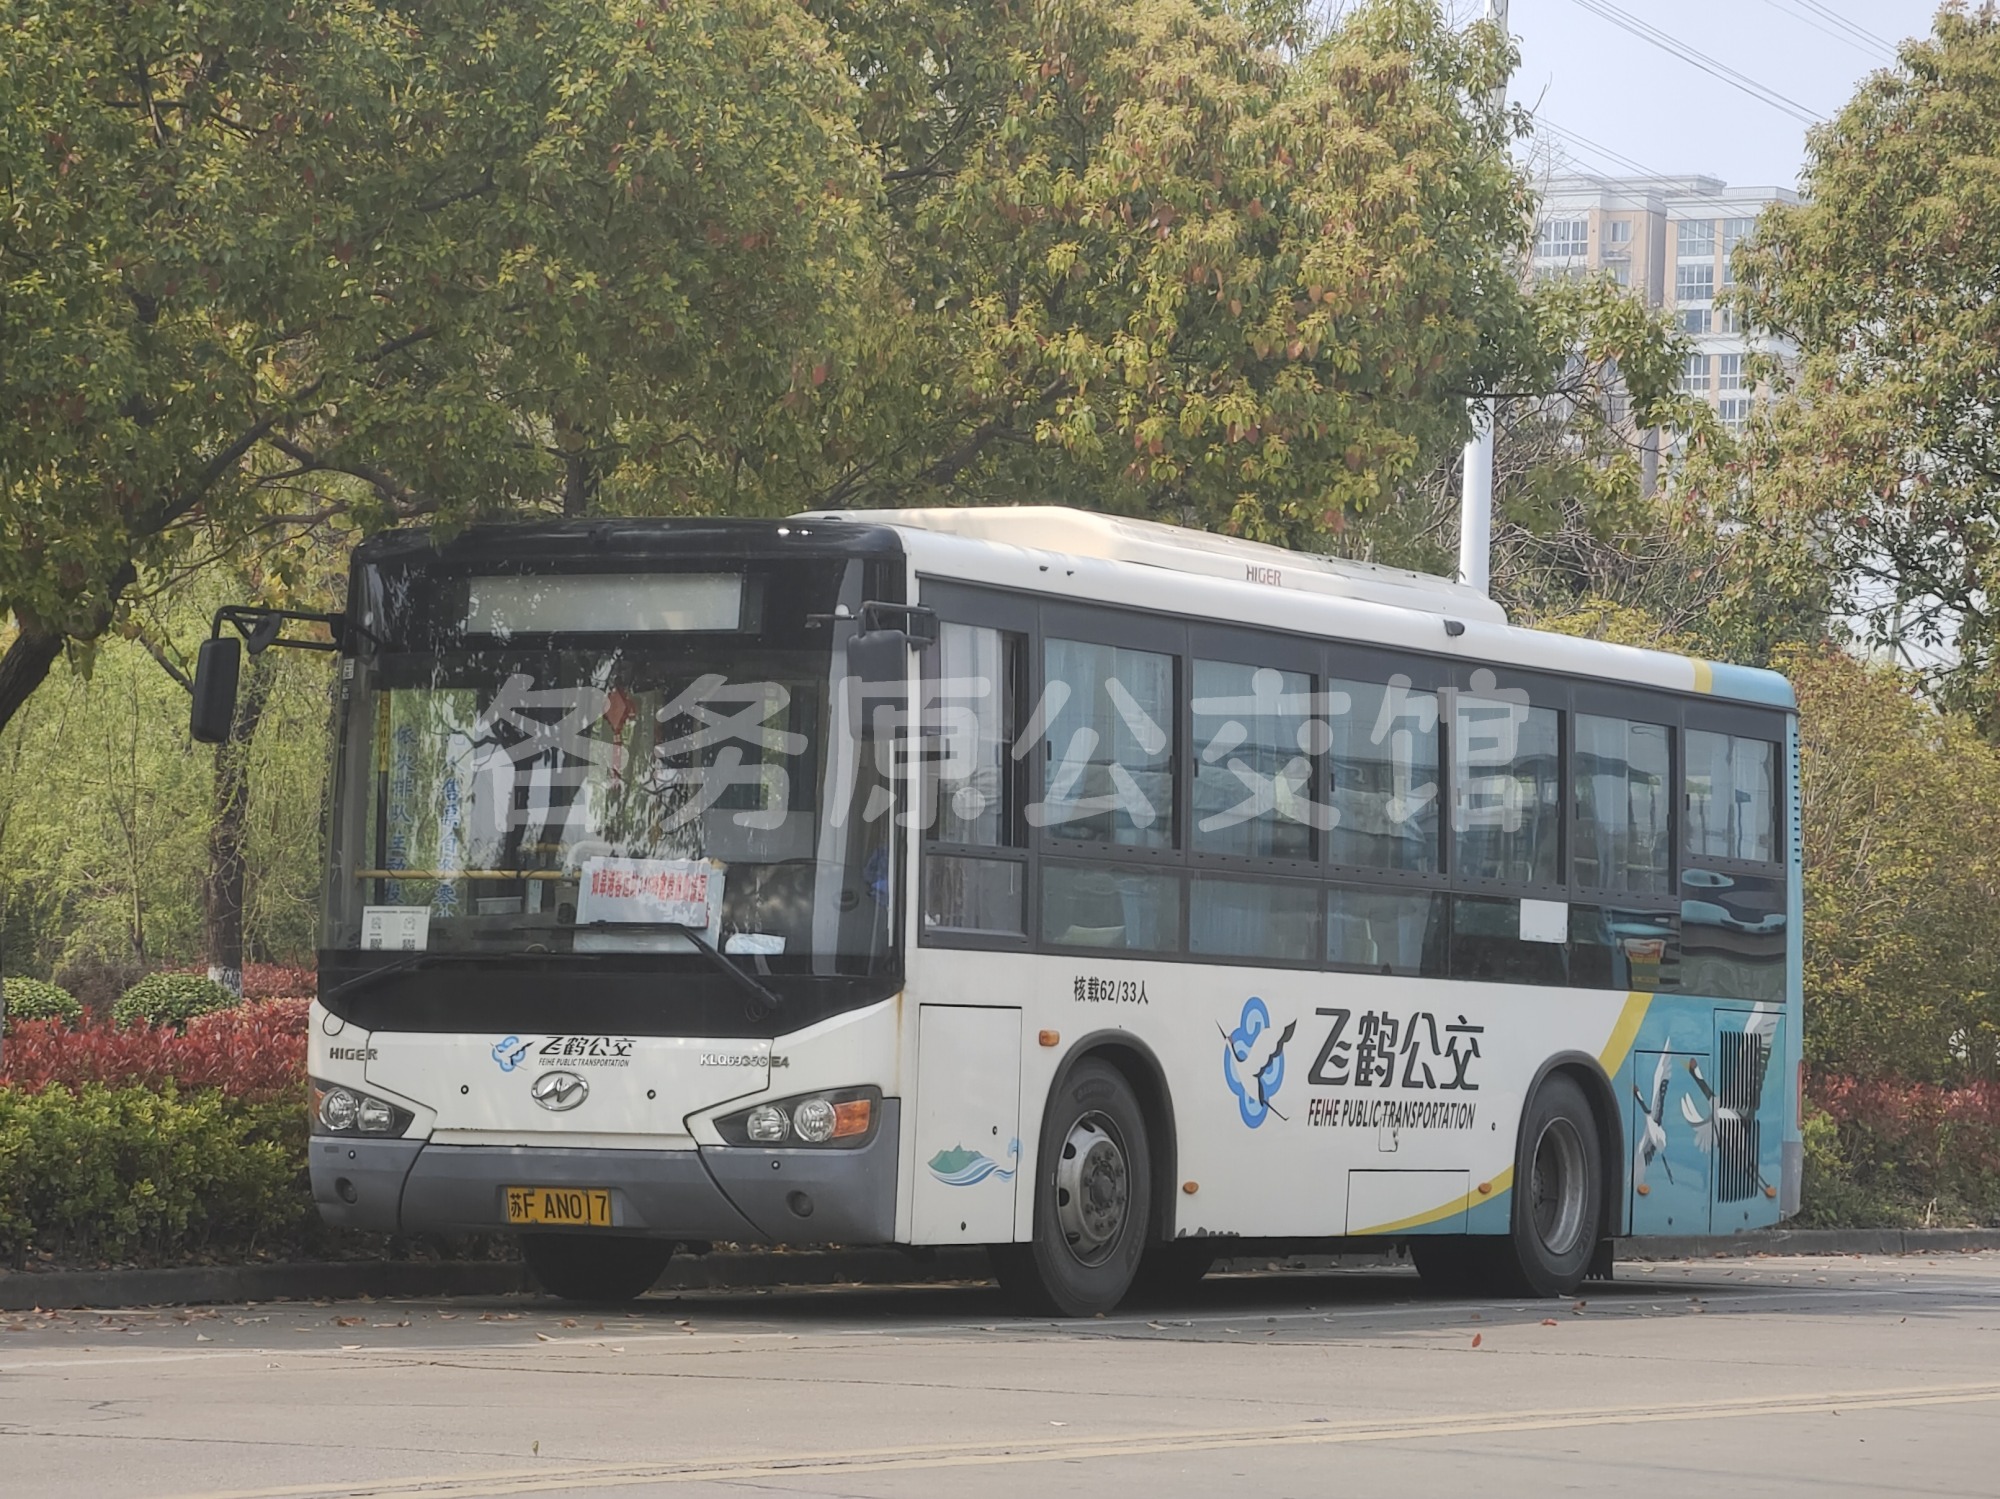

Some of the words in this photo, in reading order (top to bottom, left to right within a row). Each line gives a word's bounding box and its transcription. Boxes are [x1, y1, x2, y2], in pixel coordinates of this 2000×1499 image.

[1246, 564, 1281, 587] HIGER
[1074, 976, 1149, 1005] 核载62/33人
[330, 1047, 378, 1061] HIGER
[539, 1036, 637, 1057] 飞鹤公交
[1307, 1007, 1484, 1091] 飞鹤公交
[538, 1058, 555, 1067] FEIHE
[556, 1058, 577, 1067] PUBLIC
[578, 1059, 630, 1068] TRANSPORTATION
[1307, 1099, 1340, 1127] FEIHE
[1341, 1099, 1381, 1128] PUBLIC
[1382, 1100, 1476, 1130] TRANSPORTATION
